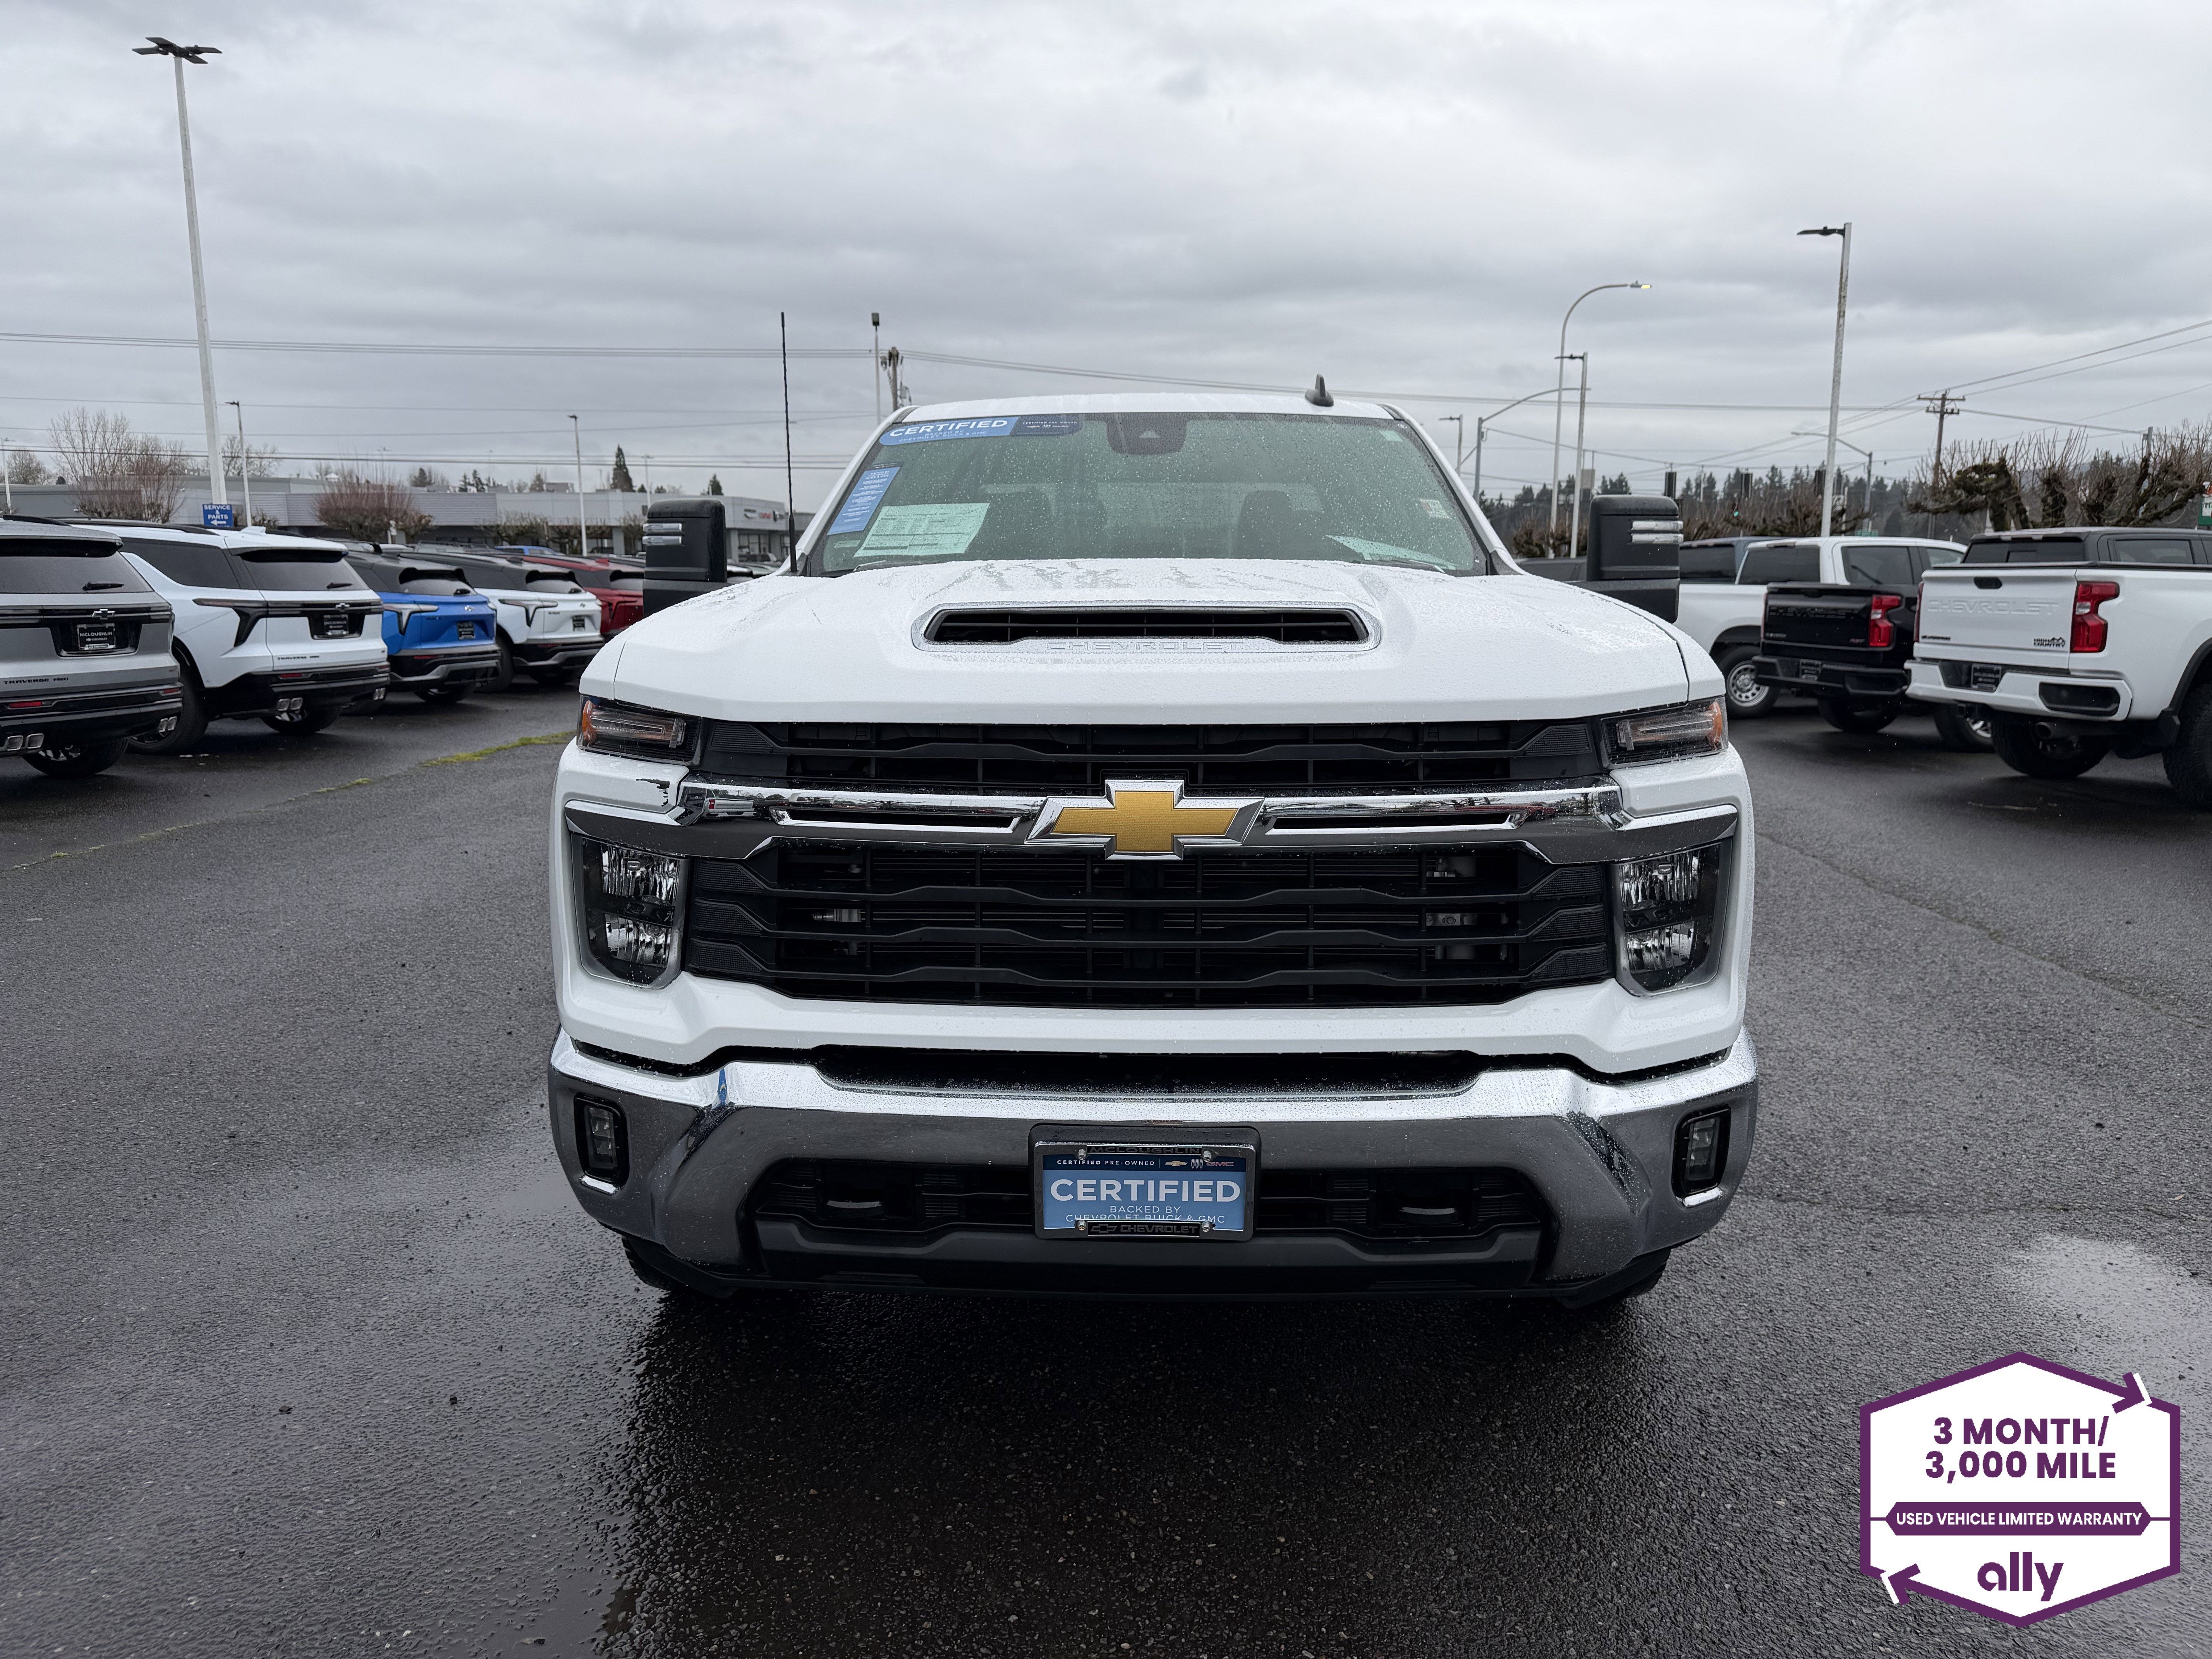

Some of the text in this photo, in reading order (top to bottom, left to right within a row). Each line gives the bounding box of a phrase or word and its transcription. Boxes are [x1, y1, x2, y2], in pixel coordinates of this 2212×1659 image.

[890, 420, 1008, 436] CERTIFIED
[1927, 600, 2059, 615] CHEVROLET
[1046, 642, 1244, 650] CHEVROLET
[1050, 1179, 1240, 1202] CERTIFIED
[1120, 1225, 1198, 1233] CHEVROLET
